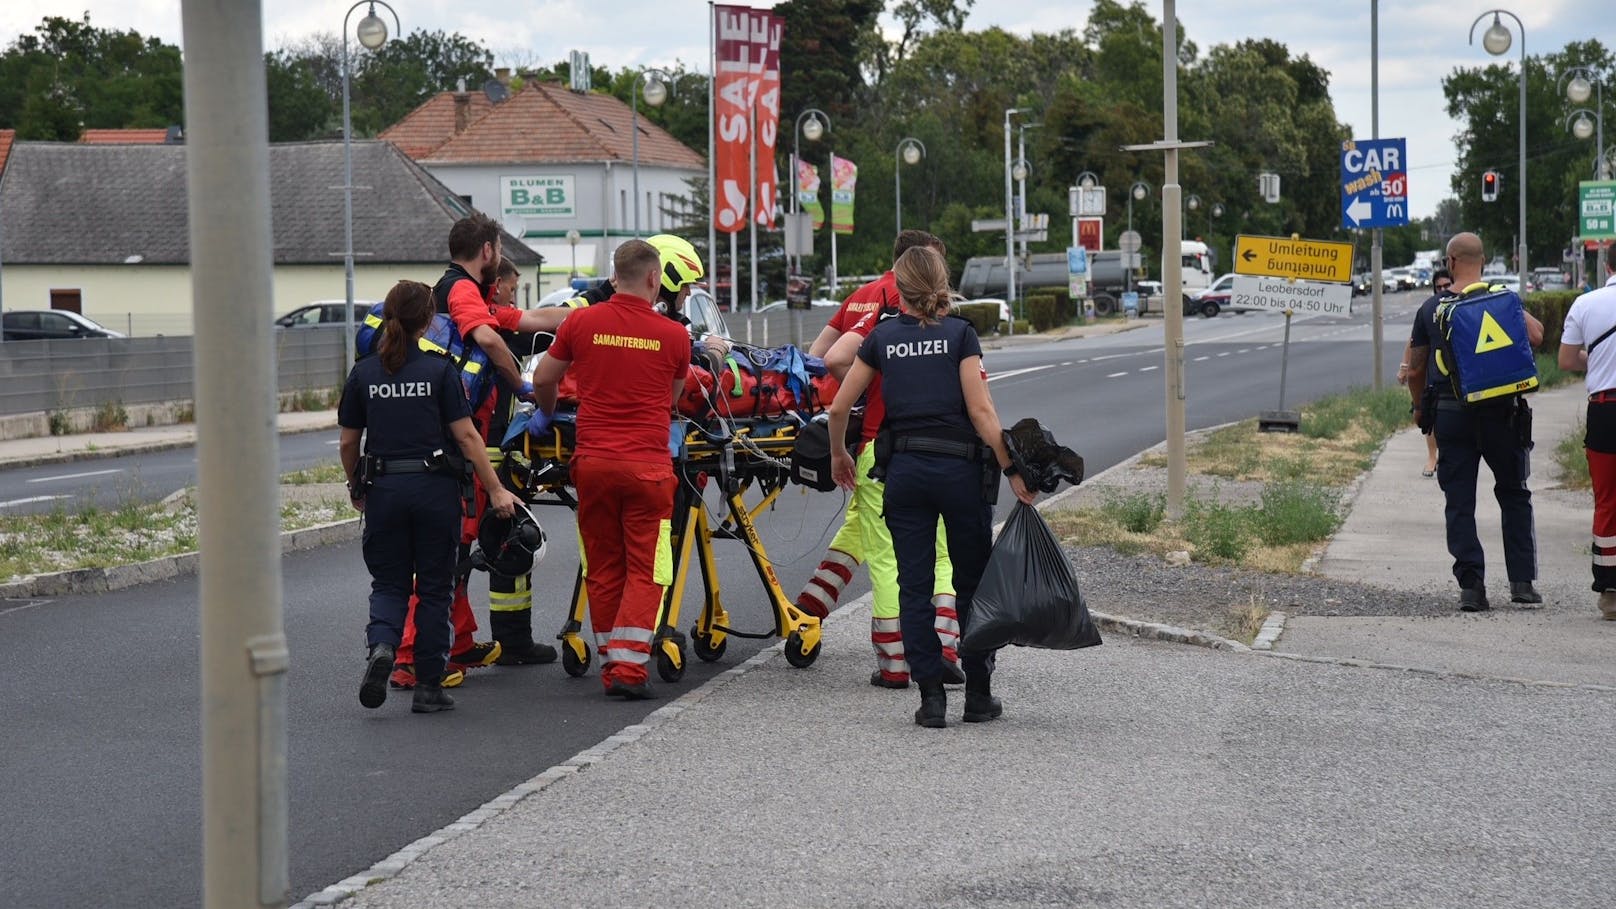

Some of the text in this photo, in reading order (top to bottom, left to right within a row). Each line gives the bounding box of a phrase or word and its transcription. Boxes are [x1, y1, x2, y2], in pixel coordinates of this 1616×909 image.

[719, 11, 749, 145] SALE
[1344, 147, 1400, 173] CAR
[510, 179, 564, 187] BLUMEN
[1344, 167, 1383, 196] wash
[1381, 180, 1403, 196] 50
[511, 188, 566, 206] B&B
[1586, 218, 1599, 230] 50
[1268, 241, 1339, 261] Umleitung
[1267, 258, 1337, 277] Umleitung
[1258, 281, 1326, 298] Leobersdorf
[1236, 294, 1345, 313] 22:00 bis 04:50 Uhr
[592, 333, 661, 352] SAMARITERBUND
[886, 339, 949, 360] POLIZEI
[368, 381, 432, 399] POLIZEI
[737, 505, 761, 545] stryker
